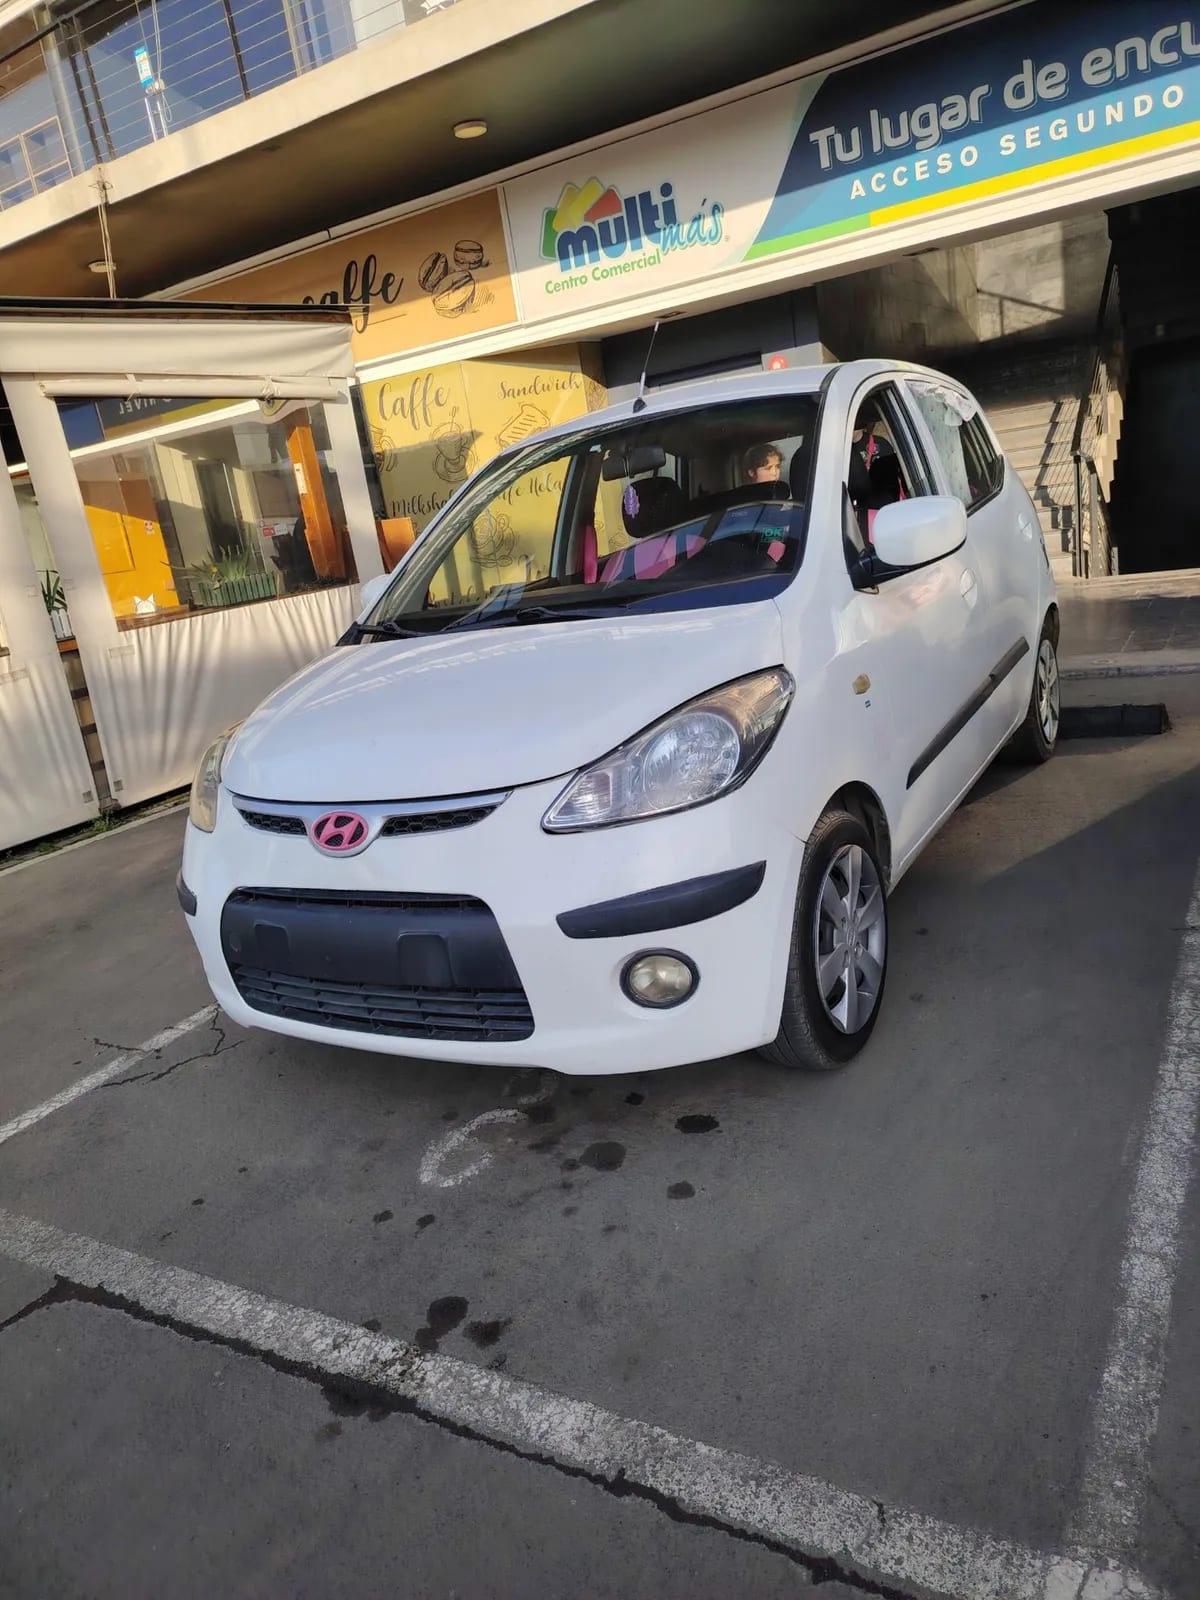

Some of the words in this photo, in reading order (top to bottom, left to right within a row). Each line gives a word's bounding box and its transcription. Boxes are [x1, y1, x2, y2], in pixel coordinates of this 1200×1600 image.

[809, 125, 862, 169] Tu
[870, 84, 991, 154] lugar
[1003, 59, 1068, 110] de
[850, 146, 979, 200] ACCESO
[999, 84, 1184, 156] SEGUNDO
[557, 182, 677, 272] multi
[659, 198, 725, 255] más
[545, 273, 588, 294] Centro
[591, 248, 661, 282] Comercial
[378, 372, 450, 431] Caffe
[500, 371, 580, 399] Sandwich
